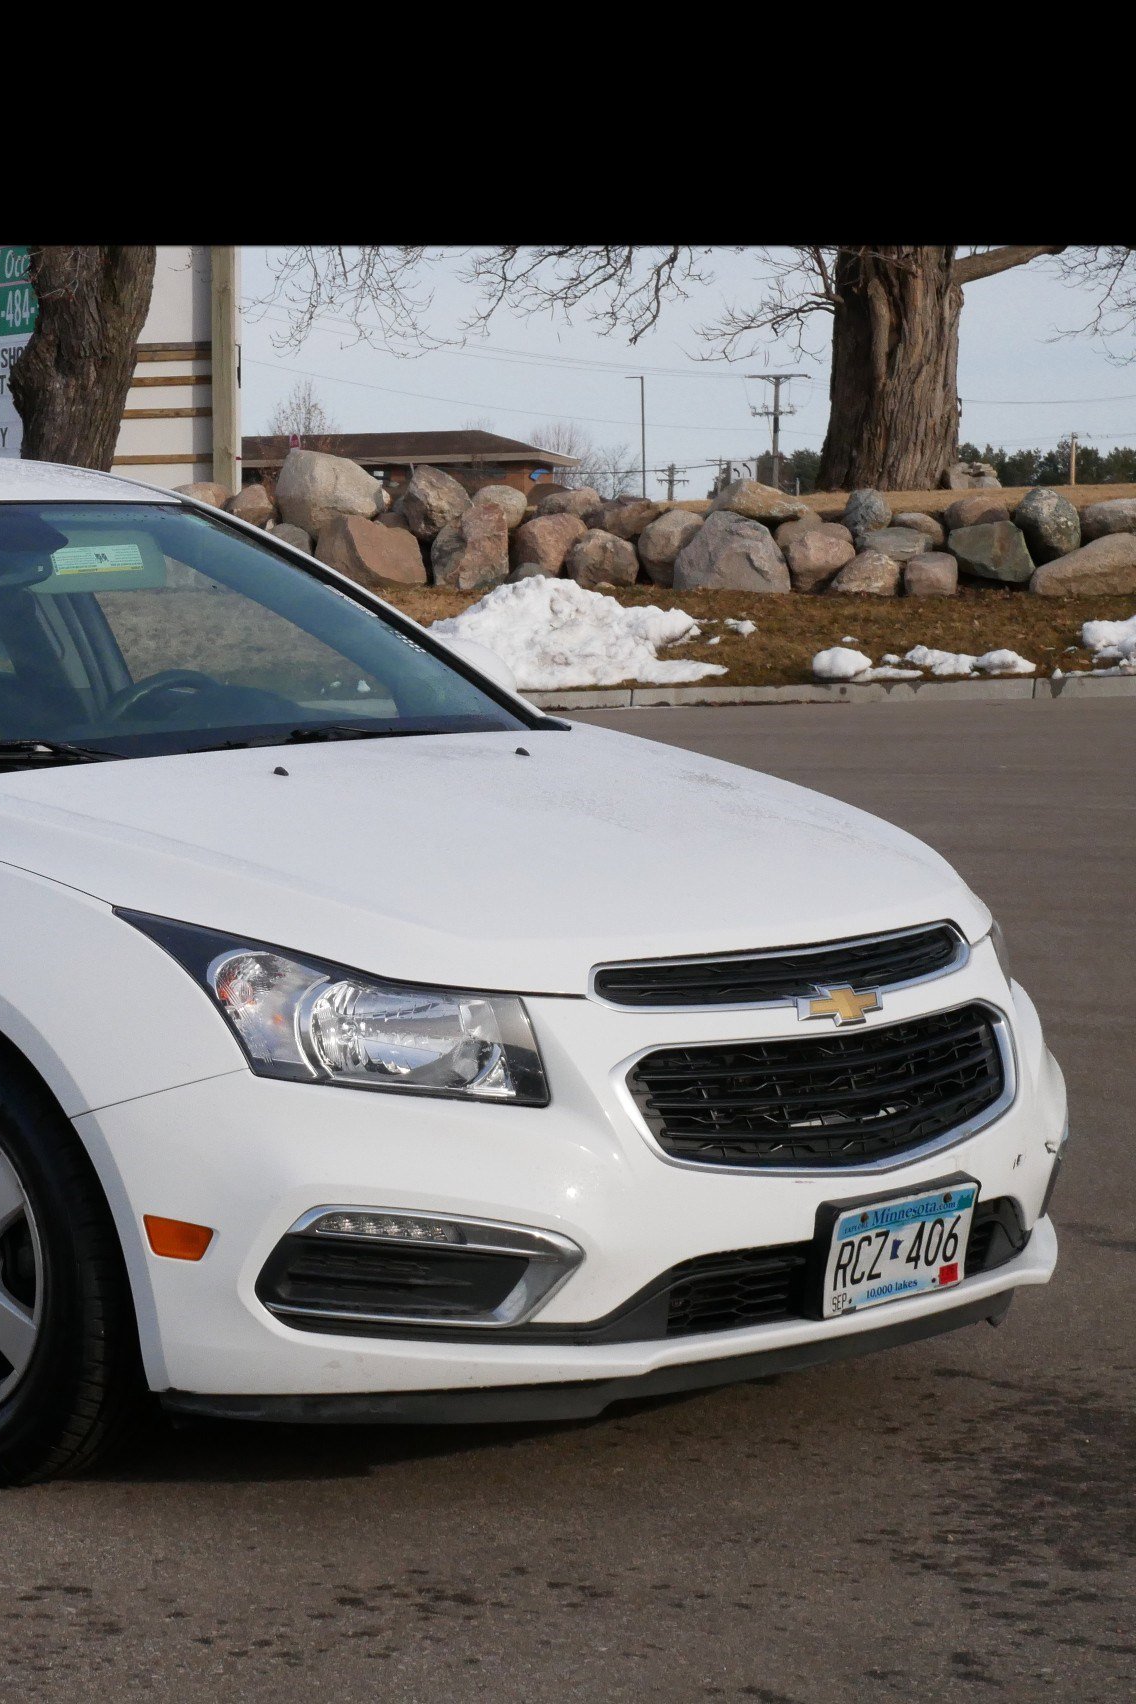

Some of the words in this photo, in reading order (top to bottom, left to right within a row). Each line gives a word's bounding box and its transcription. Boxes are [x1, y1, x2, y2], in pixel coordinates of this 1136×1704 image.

[872, 1201, 956, 1226] Minnesota.com
[832, 1229, 891, 1291] RCZ
[905, 1214, 962, 1270] 406
[866, 1284, 893, 1299] 10,000
[895, 1278, 918, 1291] lakes
[832, 1292, 847, 1312] SEP
